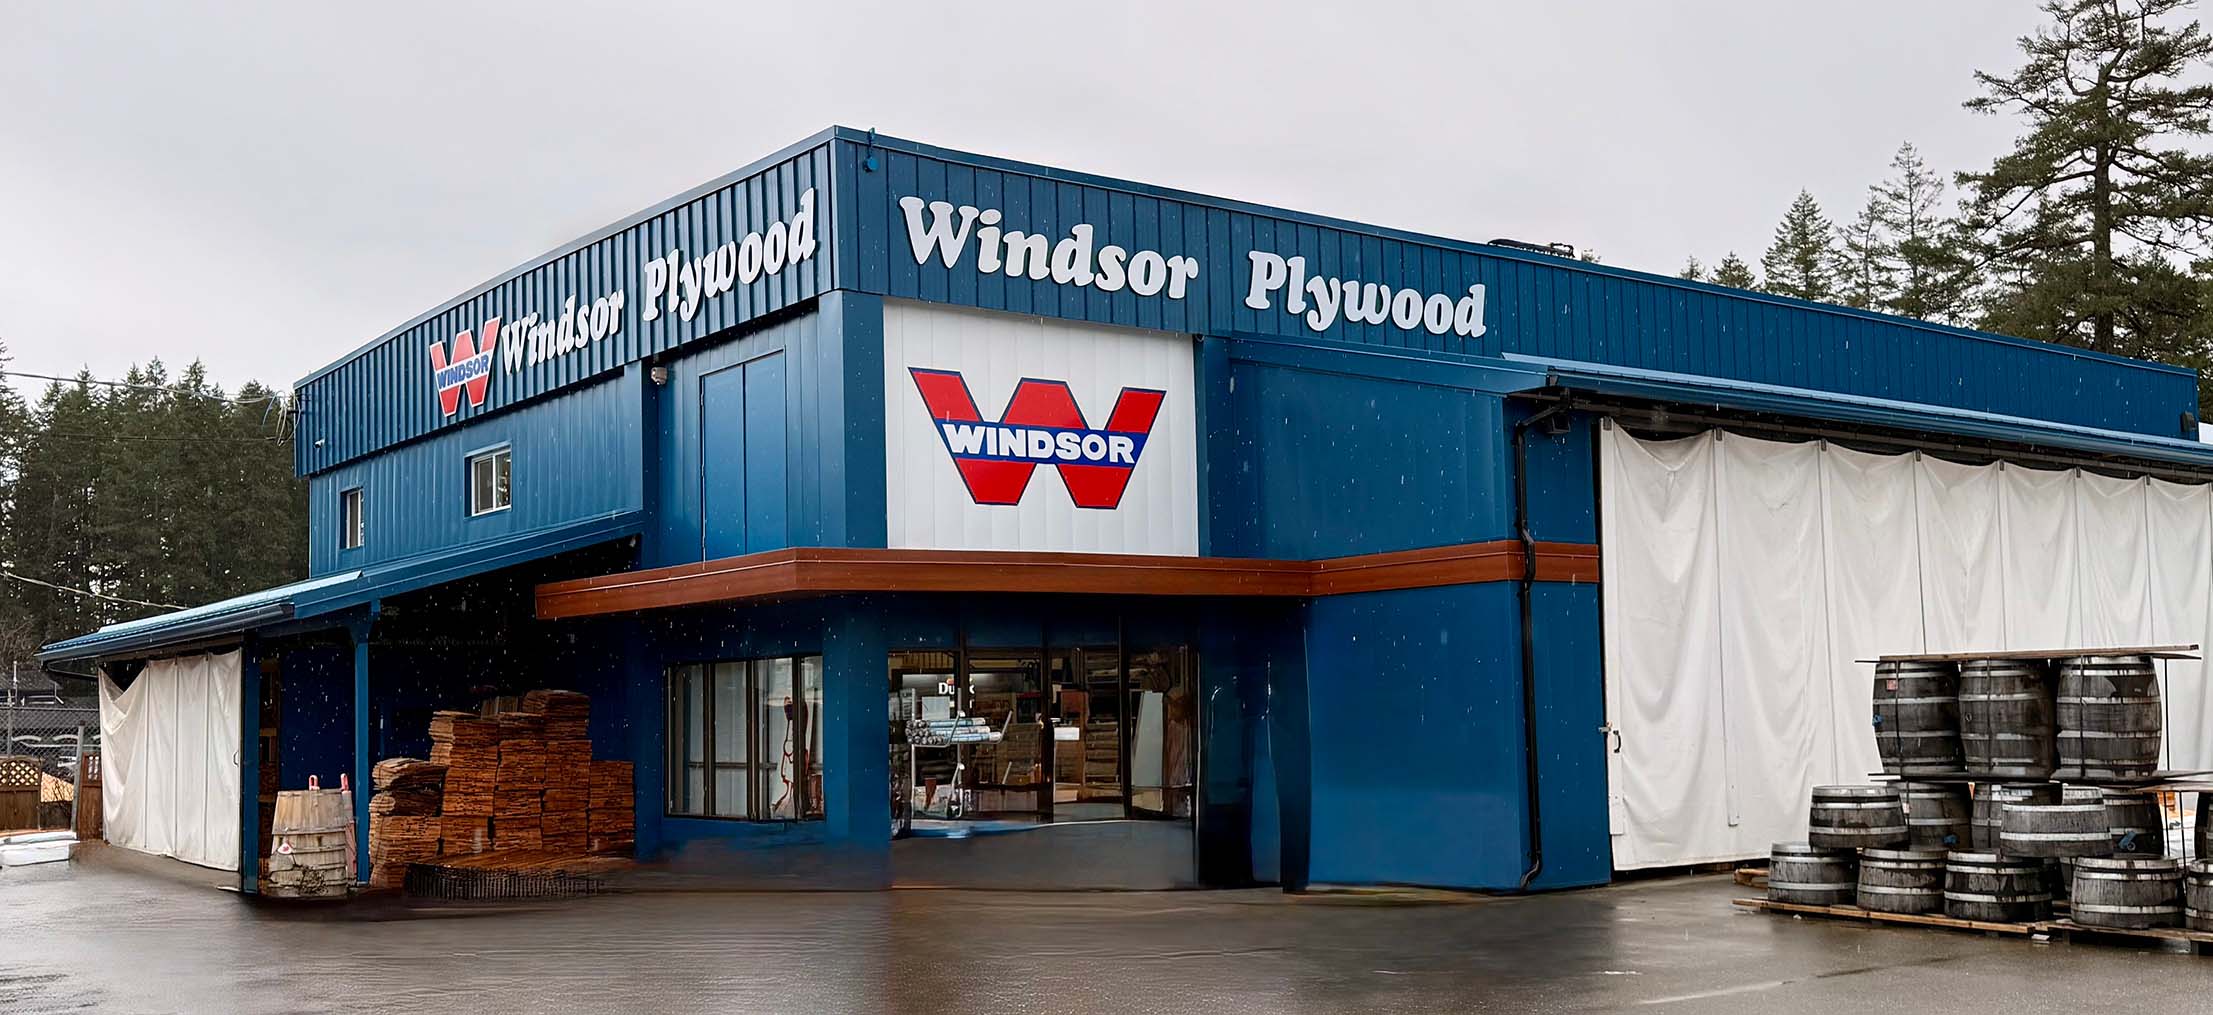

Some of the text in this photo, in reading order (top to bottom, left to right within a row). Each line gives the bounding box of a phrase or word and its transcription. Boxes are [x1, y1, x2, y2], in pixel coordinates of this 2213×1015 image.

[501, 187, 816, 376] Windsor Plywood
[900, 197, 1487, 338] Windsor Plywood
[437, 354, 489, 390] WINDSOR
[942, 424, 1135, 464] WINDSOR
